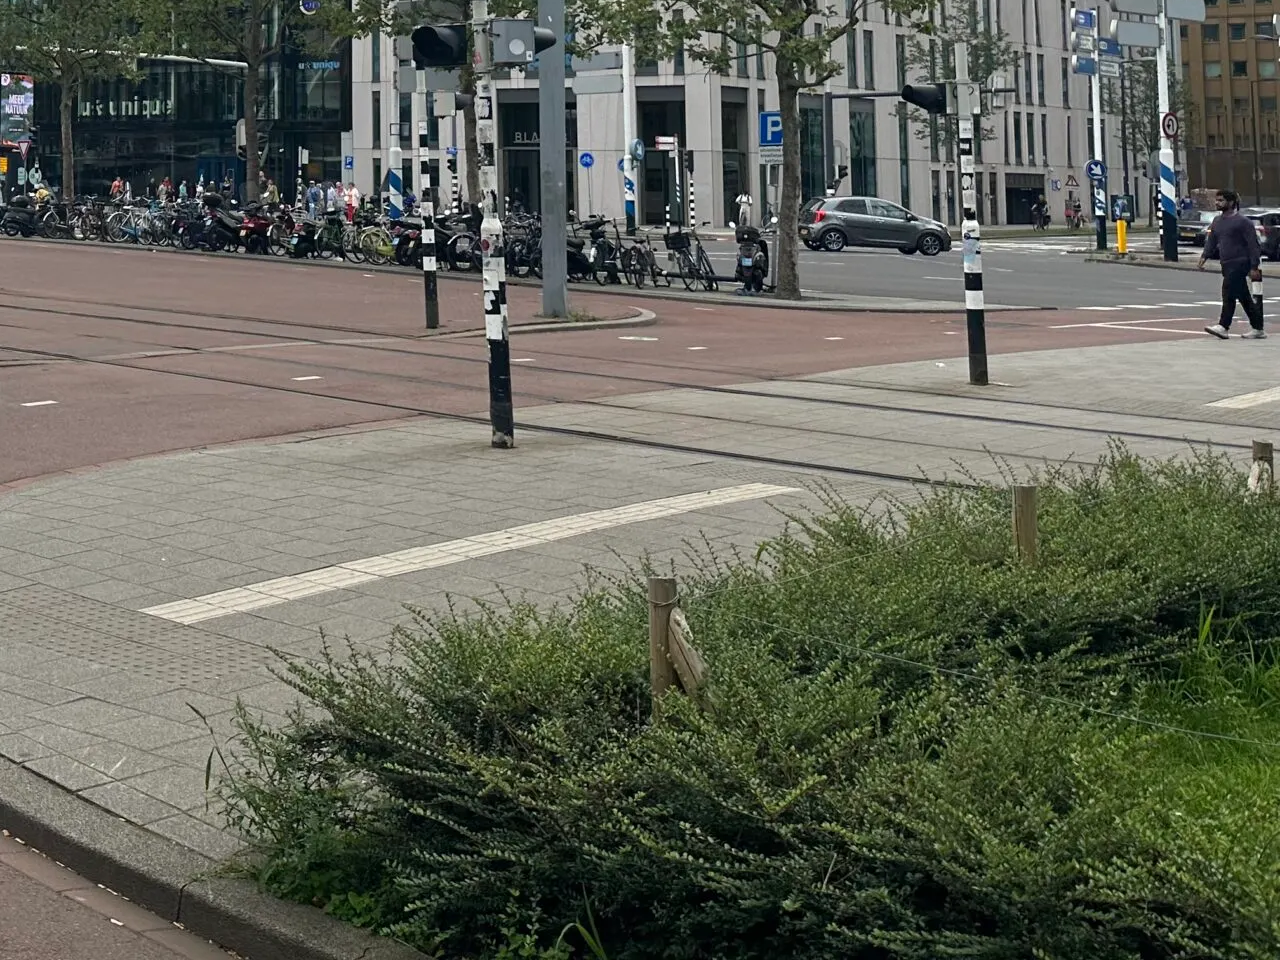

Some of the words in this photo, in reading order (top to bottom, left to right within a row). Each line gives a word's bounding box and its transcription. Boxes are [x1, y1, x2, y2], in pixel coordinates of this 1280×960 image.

[8, 94, 25, 104] MEER
[109, 95, 173, 119] unique
[5, 104, 28, 114] NATUUR
[766, 116, 783, 141] P
